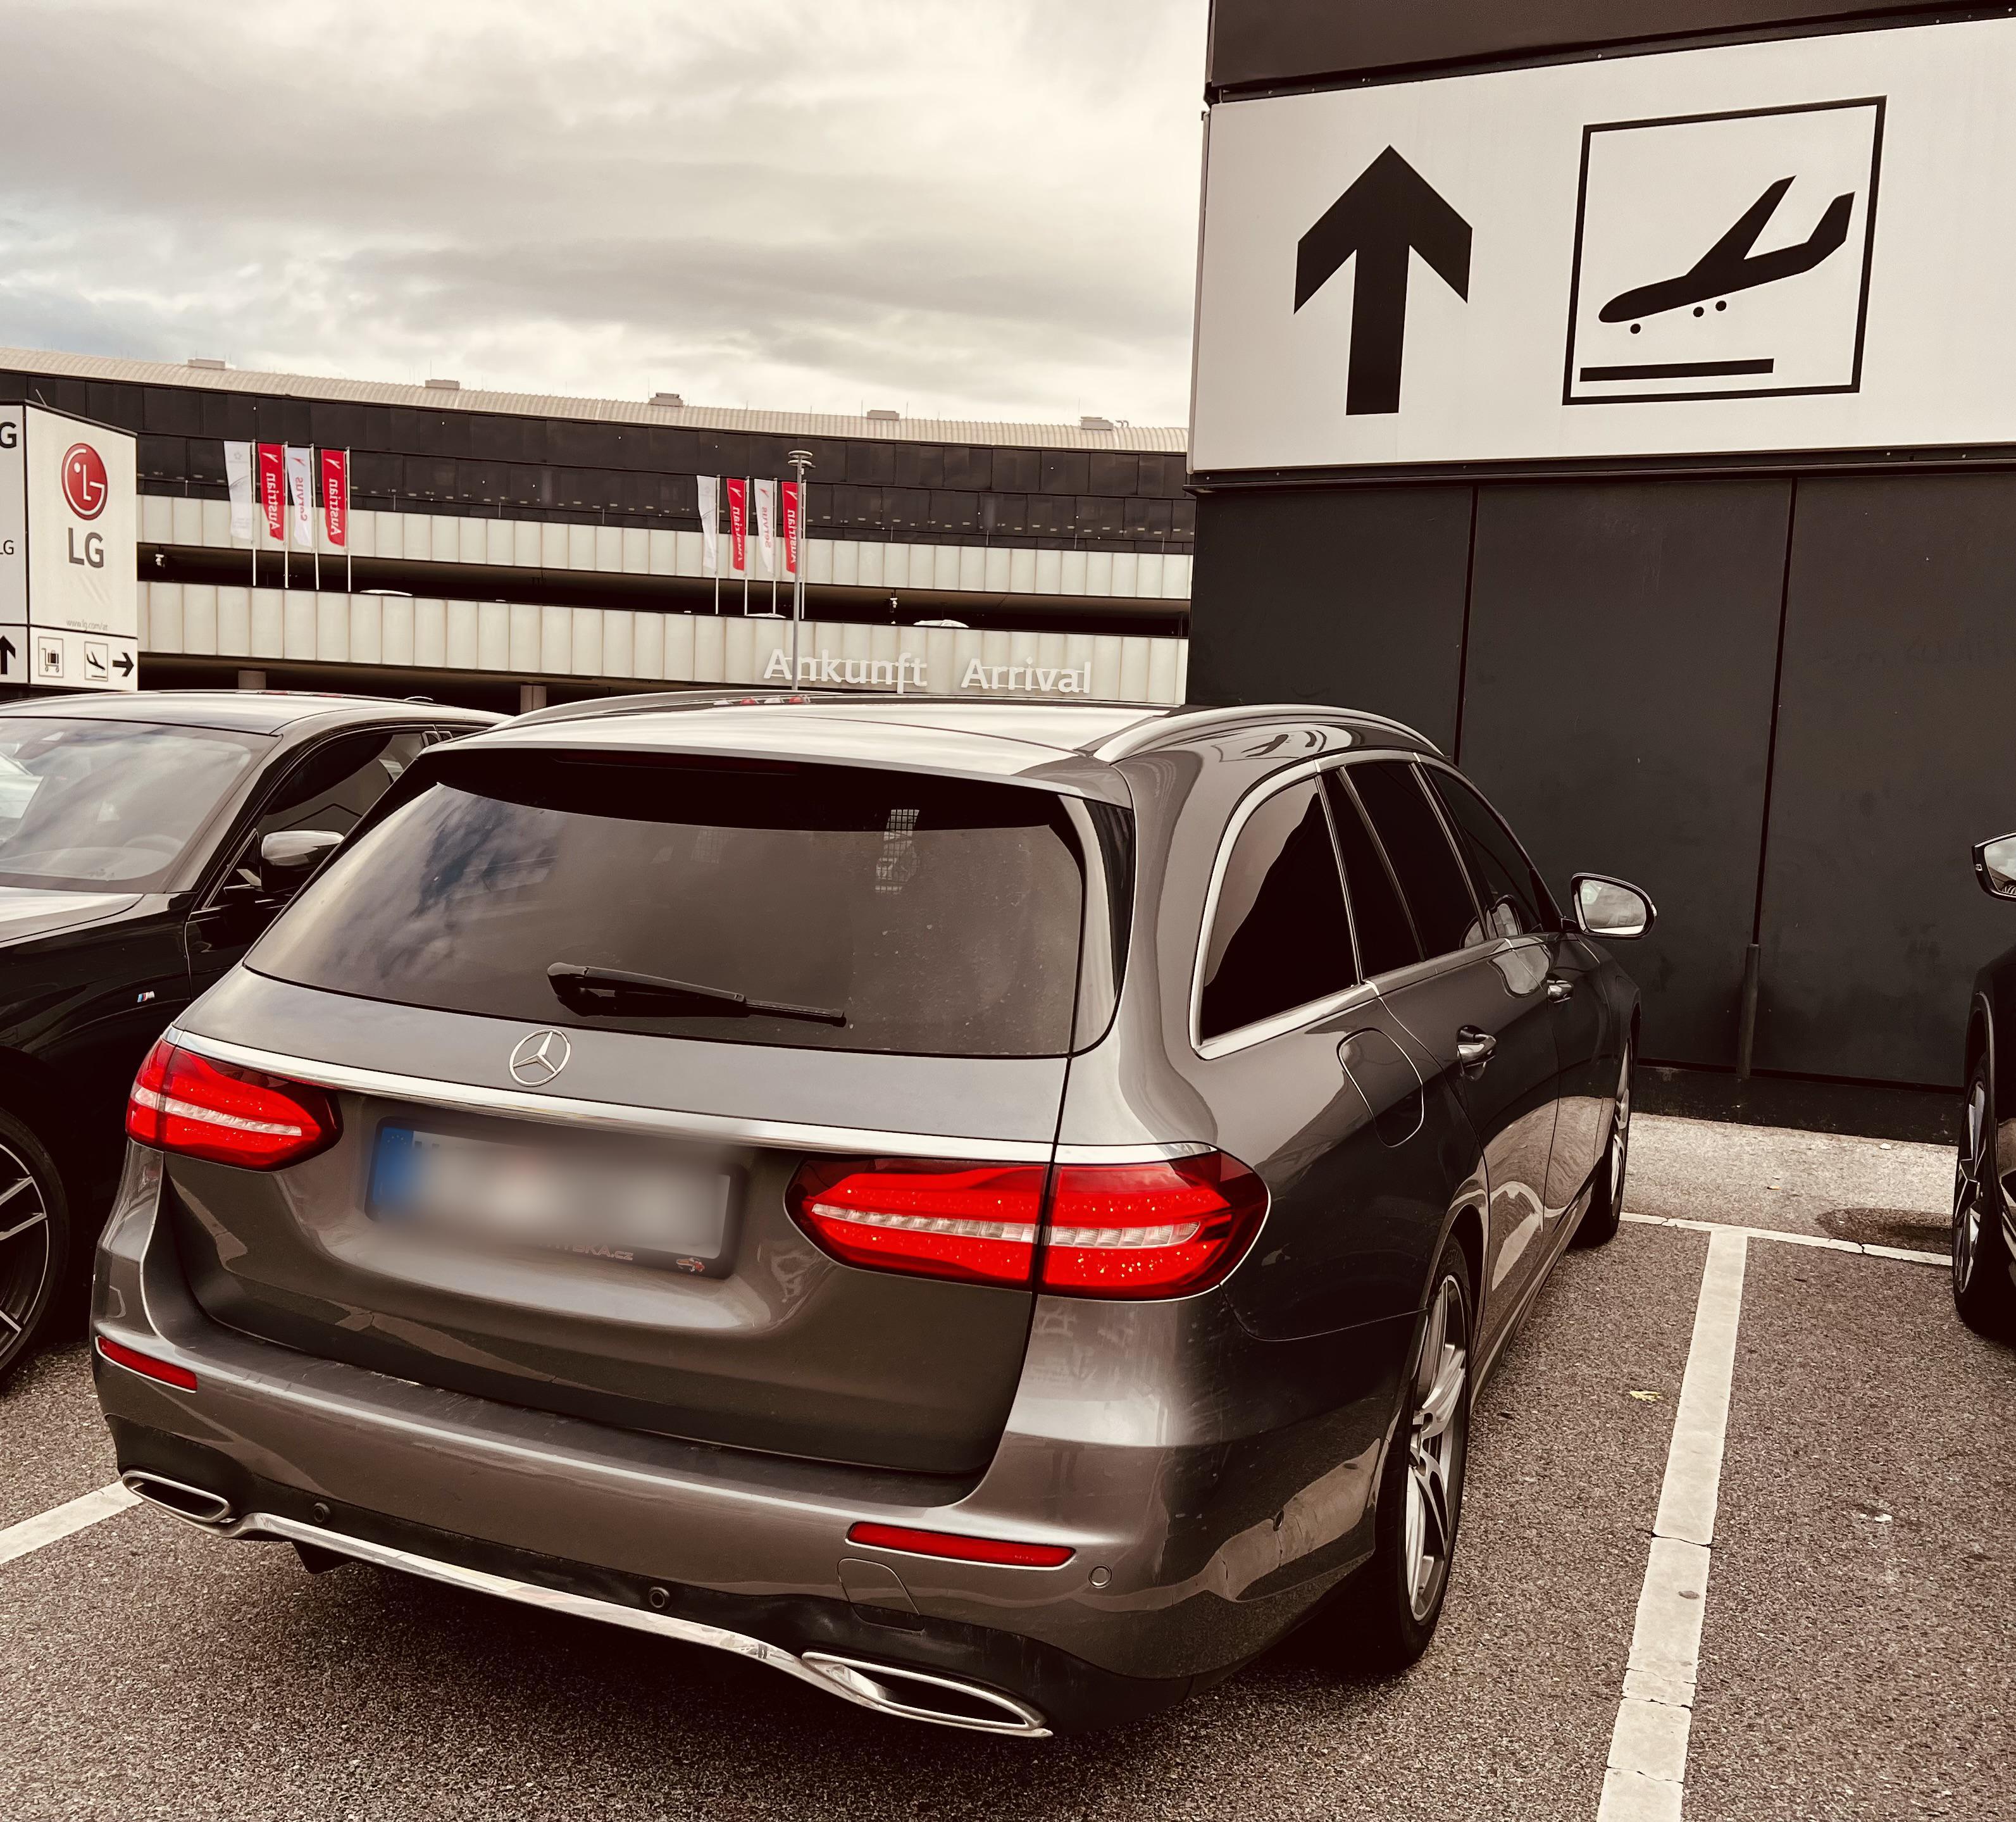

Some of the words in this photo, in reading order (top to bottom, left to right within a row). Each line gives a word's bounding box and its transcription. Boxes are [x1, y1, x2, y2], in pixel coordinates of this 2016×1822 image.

[68, 527, 104, 568] LG
[763, 649, 928, 694] Ankunft
[961, 656, 1092, 694] Arrival
